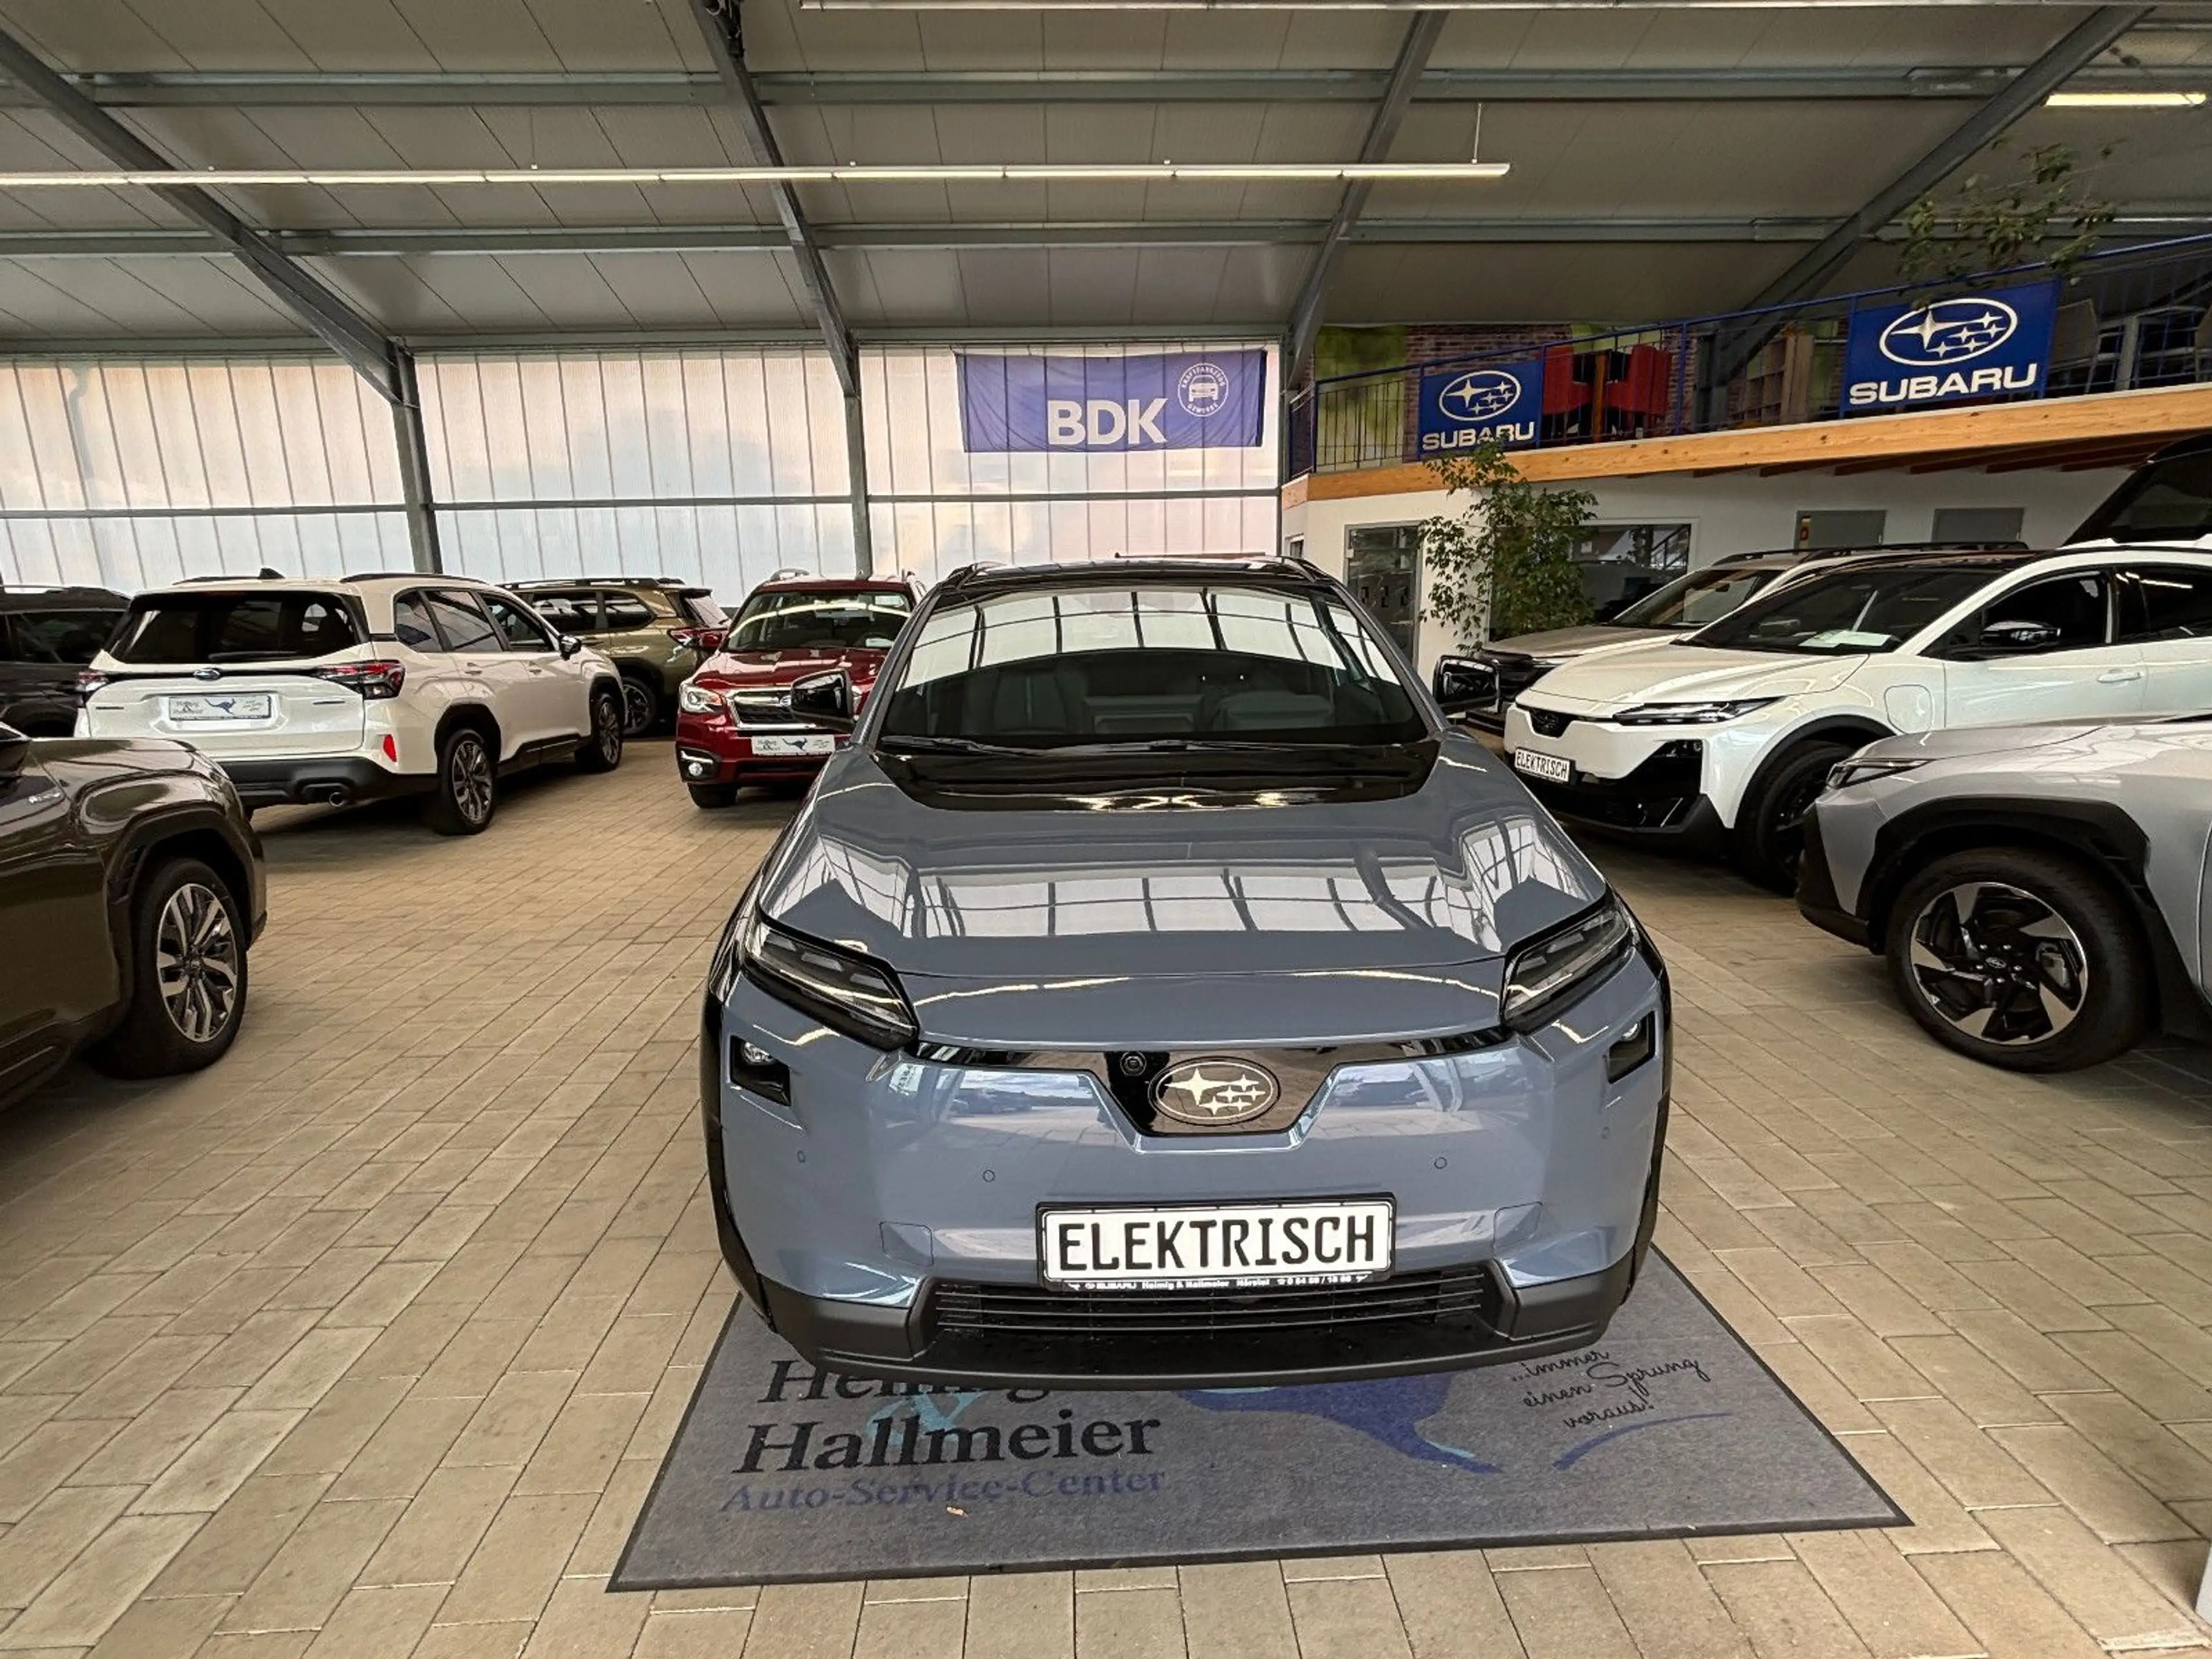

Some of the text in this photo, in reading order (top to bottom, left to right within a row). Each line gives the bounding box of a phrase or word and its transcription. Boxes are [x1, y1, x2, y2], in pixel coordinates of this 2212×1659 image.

[1849, 363, 2037, 404] SUBARU
[1047, 397, 1168, 445] BDK
[1422, 422, 1535, 450] SUBARU
[1517, 751, 1567, 779] ELEKTRISCH
[1059, 1215, 1374, 1271] ELEKTRISCH
[1523, 1358, 1711, 1407] einen Sprung
[732, 1408, 1161, 1474] Hallmeier
[721, 1468, 1165, 1512] Auto-Service-Center
